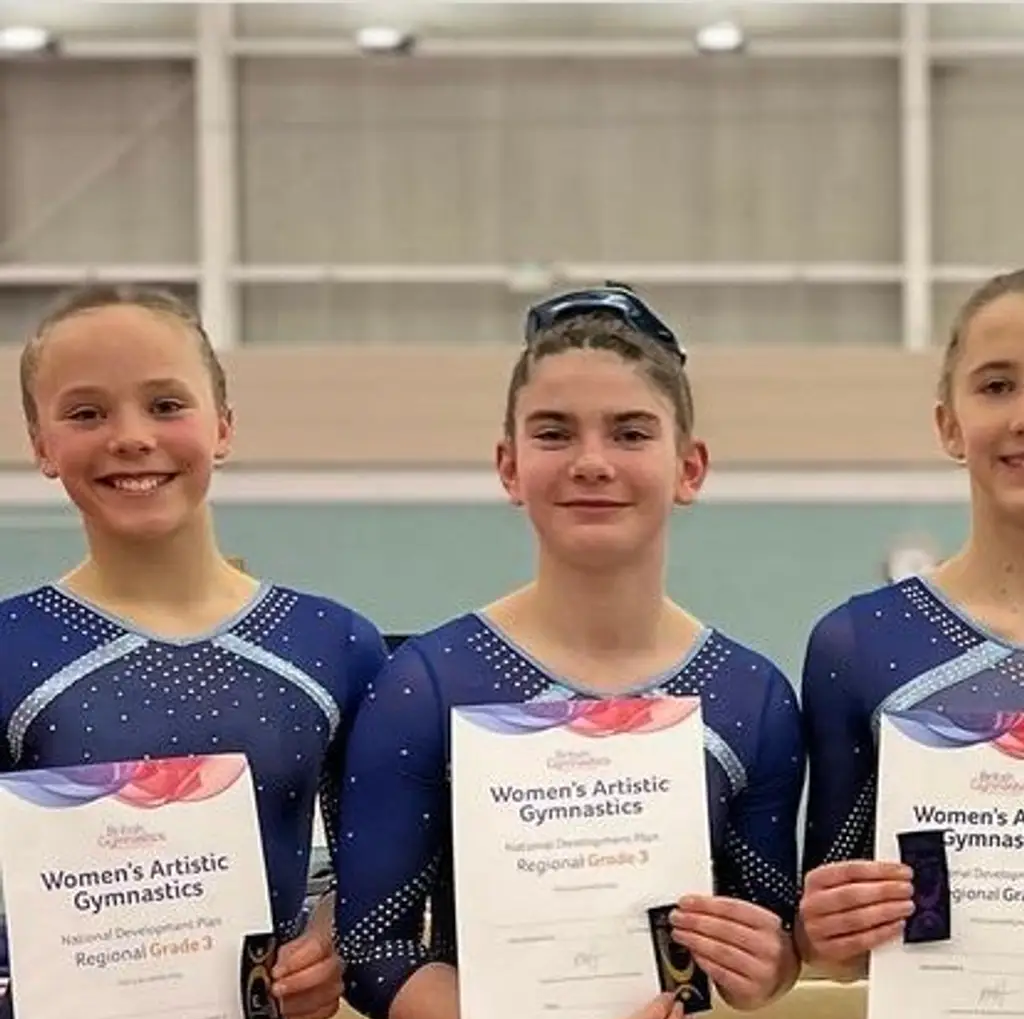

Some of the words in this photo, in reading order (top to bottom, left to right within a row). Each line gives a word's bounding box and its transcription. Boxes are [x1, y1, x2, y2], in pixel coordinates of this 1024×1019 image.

[490, 781, 587, 803] Women's
[592, 776, 670, 796] Artistic
[519, 799, 644, 826] Gymnastics
[913, 806, 1008, 826] Women's
[40, 862, 144, 891] Women's
[150, 853, 229, 879] Artistic
[517, 854, 585, 876] Regional
[588, 853, 635, 867] Grade
[639, 850, 649, 864] 3
[74, 880, 204, 914] Gymnastics
[61, 929, 112, 946] National
[115, 920, 194, 939] Development
[198, 917, 222, 929] Plan
[75, 943, 147, 968] Regional
[150, 938, 199, 957] Grade
[203, 935, 213, 951] 3
